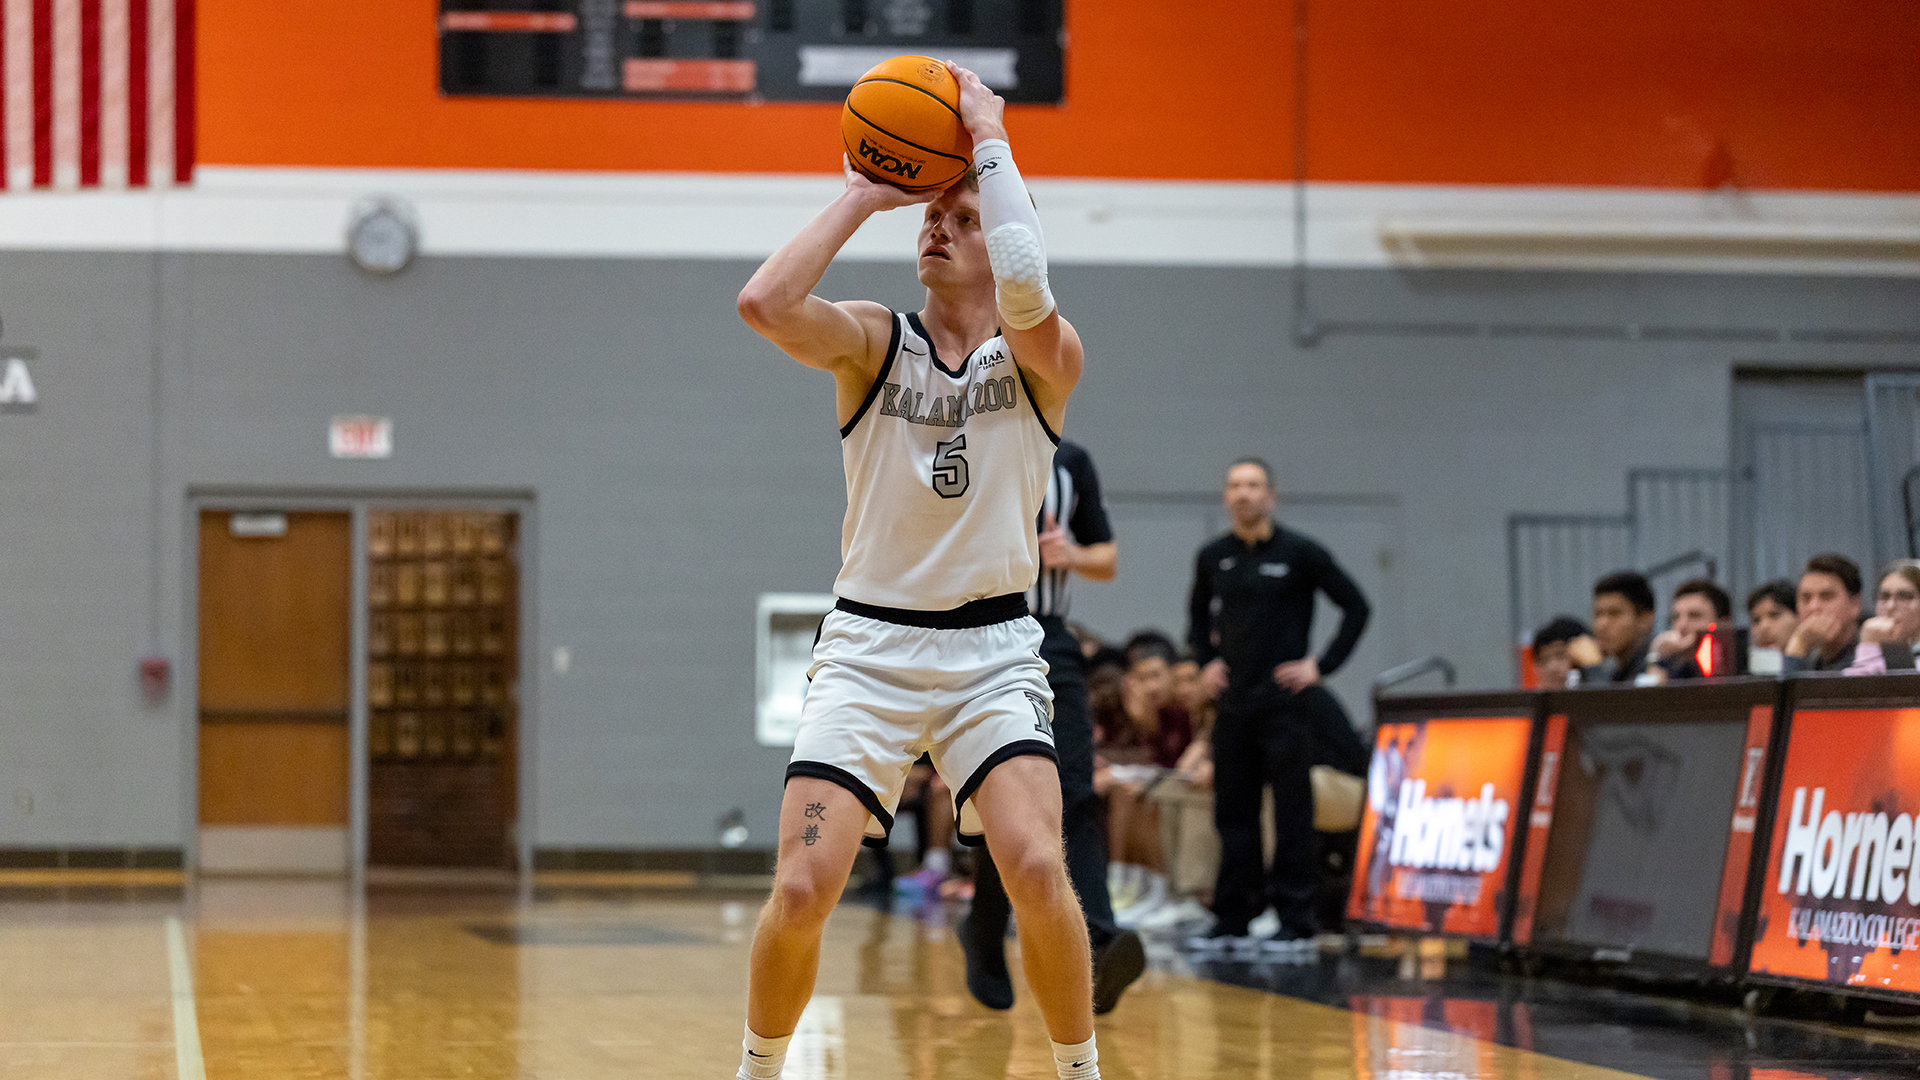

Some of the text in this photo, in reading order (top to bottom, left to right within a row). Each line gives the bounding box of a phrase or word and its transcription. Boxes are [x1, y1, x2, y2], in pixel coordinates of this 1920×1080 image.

[858, 138, 923, 180] NCAA
[932, 433, 970, 499] 5
[801, 802, 827, 846] 改善
[1390, 778, 1509, 872] Hornets
[1787, 906, 1920, 951] KALAMAZOO COLLEGE
